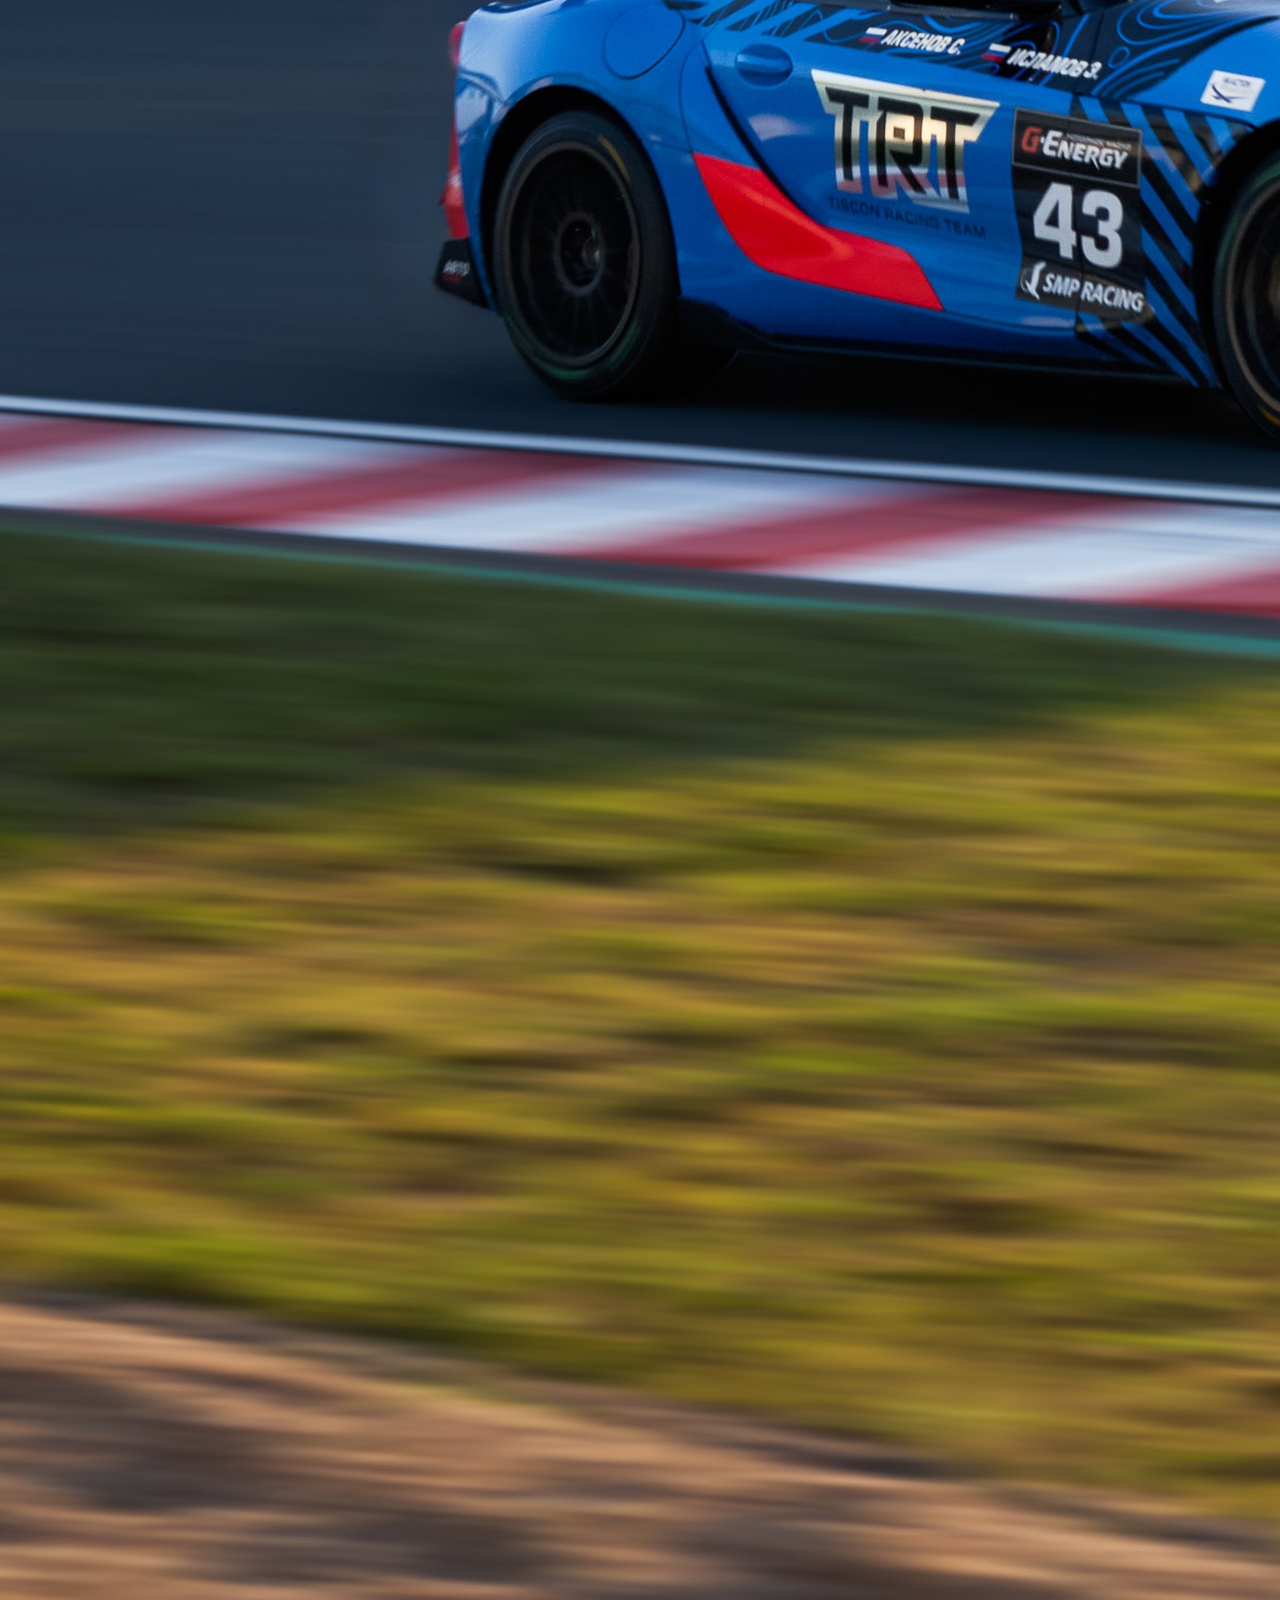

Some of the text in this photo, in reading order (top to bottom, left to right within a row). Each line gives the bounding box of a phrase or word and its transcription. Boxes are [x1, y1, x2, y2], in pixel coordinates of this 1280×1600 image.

[818, 78, 990, 206] TRT
[884, 207, 940, 229] RACING
[944, 218, 987, 240] TEAM
[1033, 182, 1124, 268] 43
[1043, 273, 1144, 312] SMP RACING
